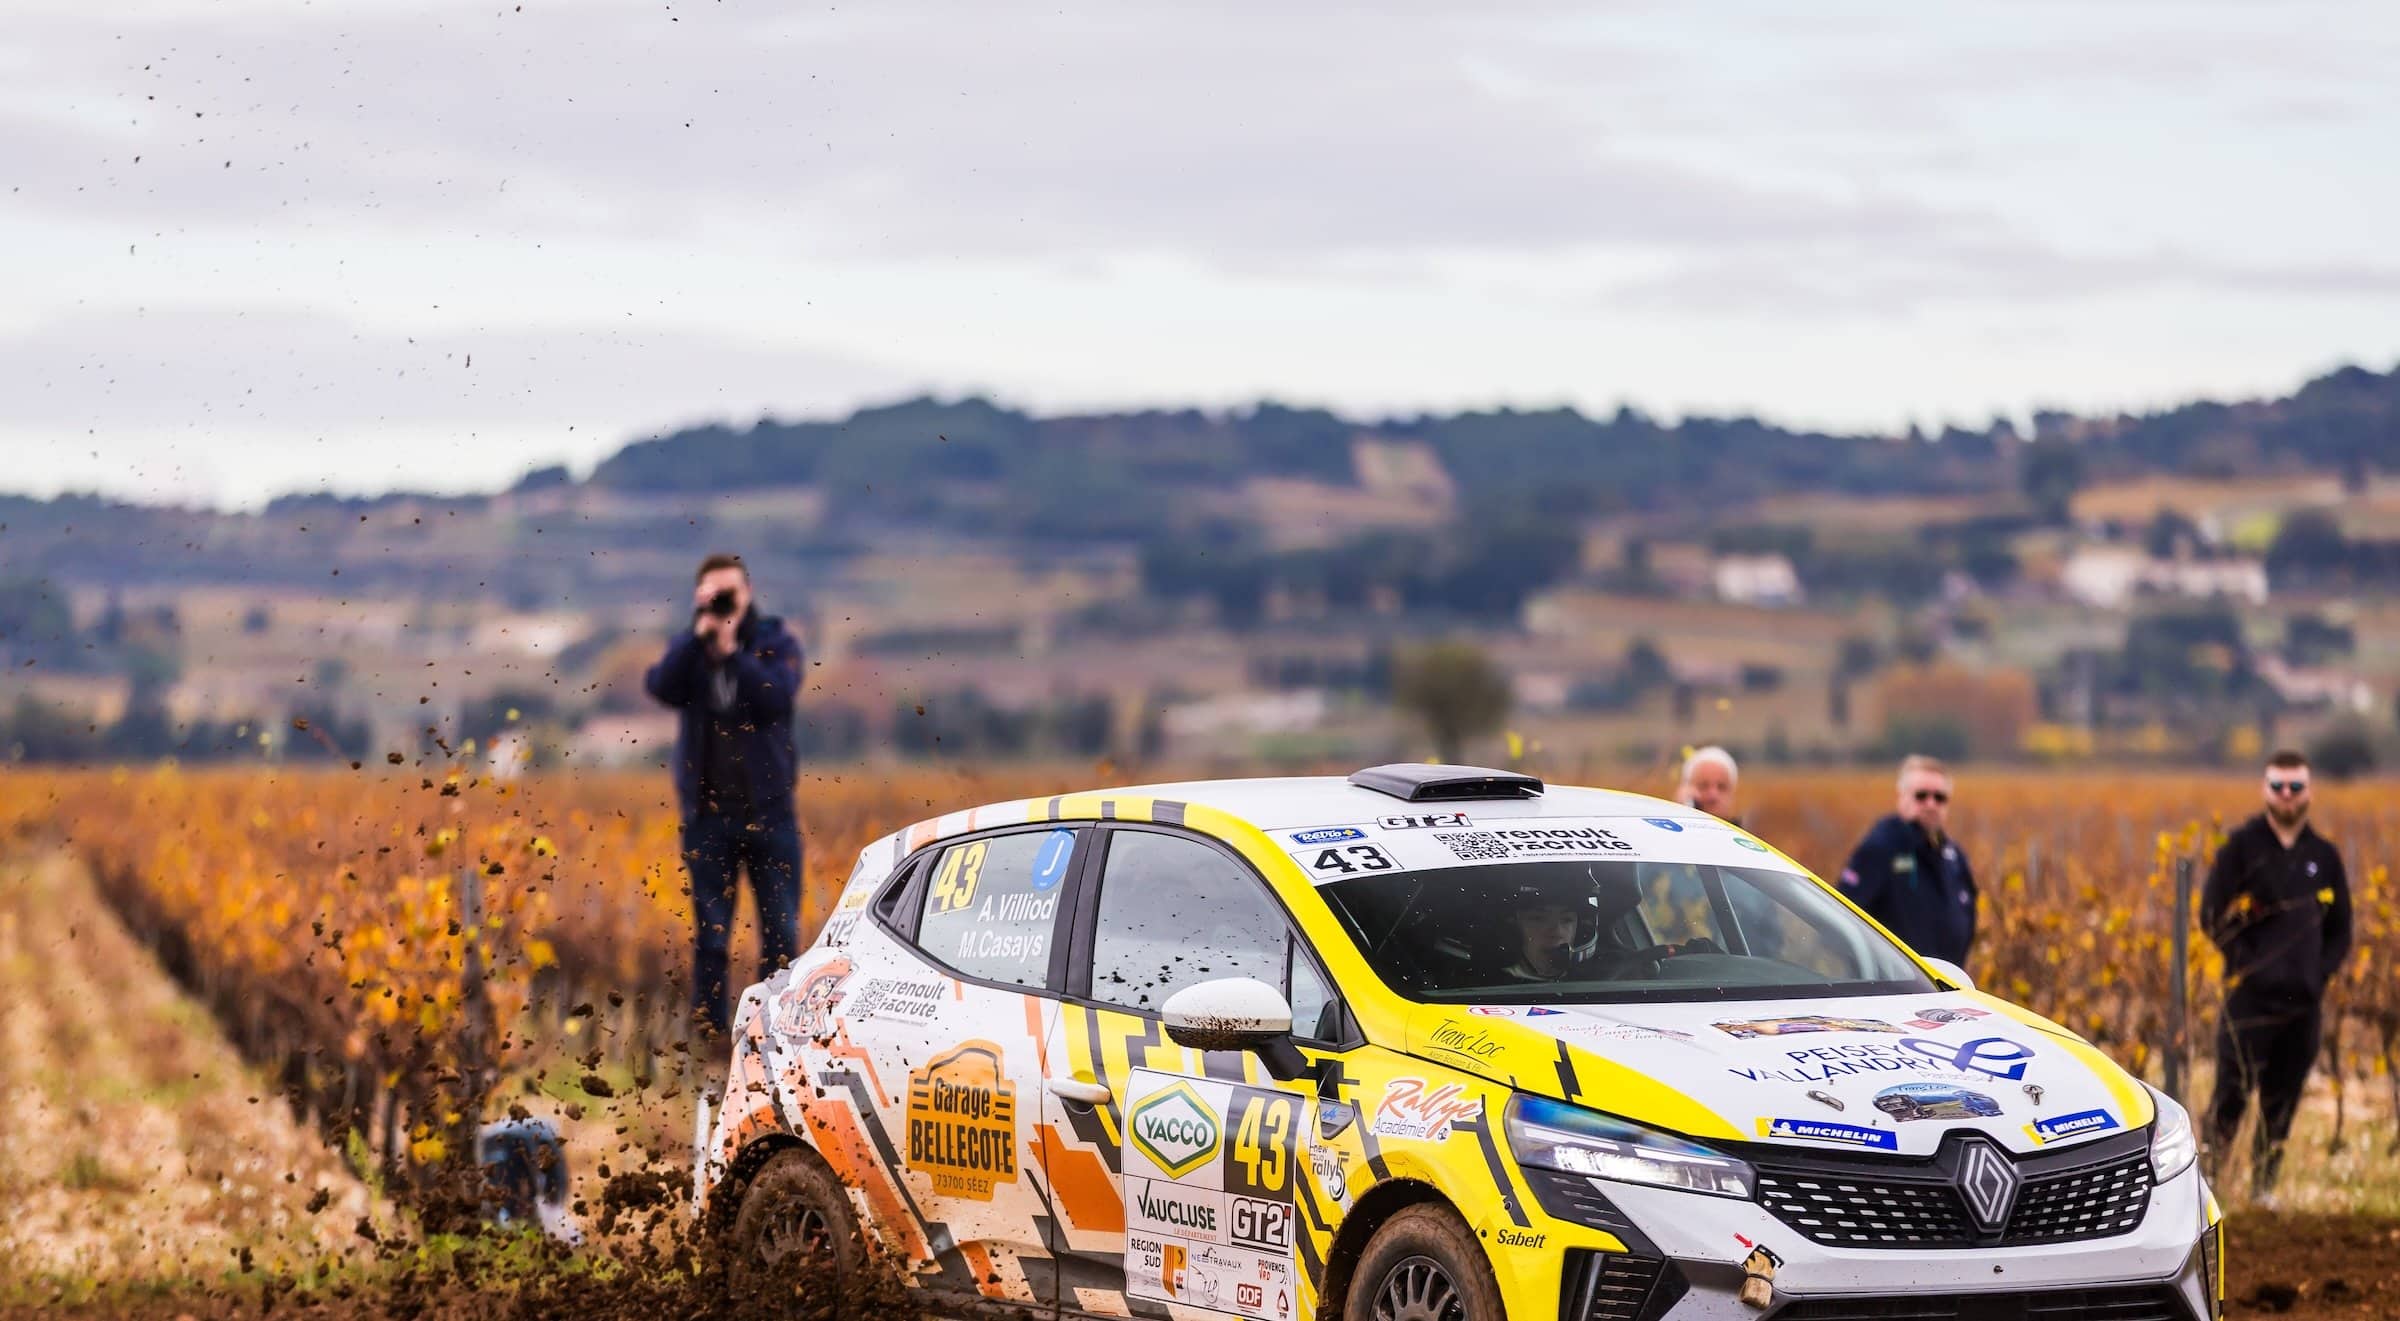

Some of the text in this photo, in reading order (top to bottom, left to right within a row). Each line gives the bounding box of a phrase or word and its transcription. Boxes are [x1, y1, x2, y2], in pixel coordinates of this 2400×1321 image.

[1380, 813, 1472, 830] GT2i
[1495, 827, 1619, 841] renault
[1041, 839, 1066, 877] J
[1313, 845, 1394, 874] 43
[934, 842, 986, 912] 43
[958, 930, 1044, 962] M.Casays
[891, 980, 946, 1001] renault
[1786, 1043, 1903, 1065] PEISEY
[1728, 1055, 1942, 1083] VALLANDRY
[934, 1077, 991, 1120] Garage
[1376, 1079, 1478, 1138] Rallye
[1144, 1115, 1208, 1148] YACCO
[1374, 1117, 1425, 1138] Académie
[1796, 1125, 1882, 1142] MICHELIN
[2052, 1114, 2106, 1134] MICHELIN
[1234, 1096, 1292, 1192] 43
[936, 1174, 990, 1193] 73700 SÉEZ
[1137, 1179, 1217, 1231] VAUCLUSE
[1231, 1198, 1293, 1248] GT2i
[1496, 1228, 1547, 1249] Sabelt
[1144, 1255, 1161, 1268] SUD
[1238, 1287, 1262, 1305] ODF
